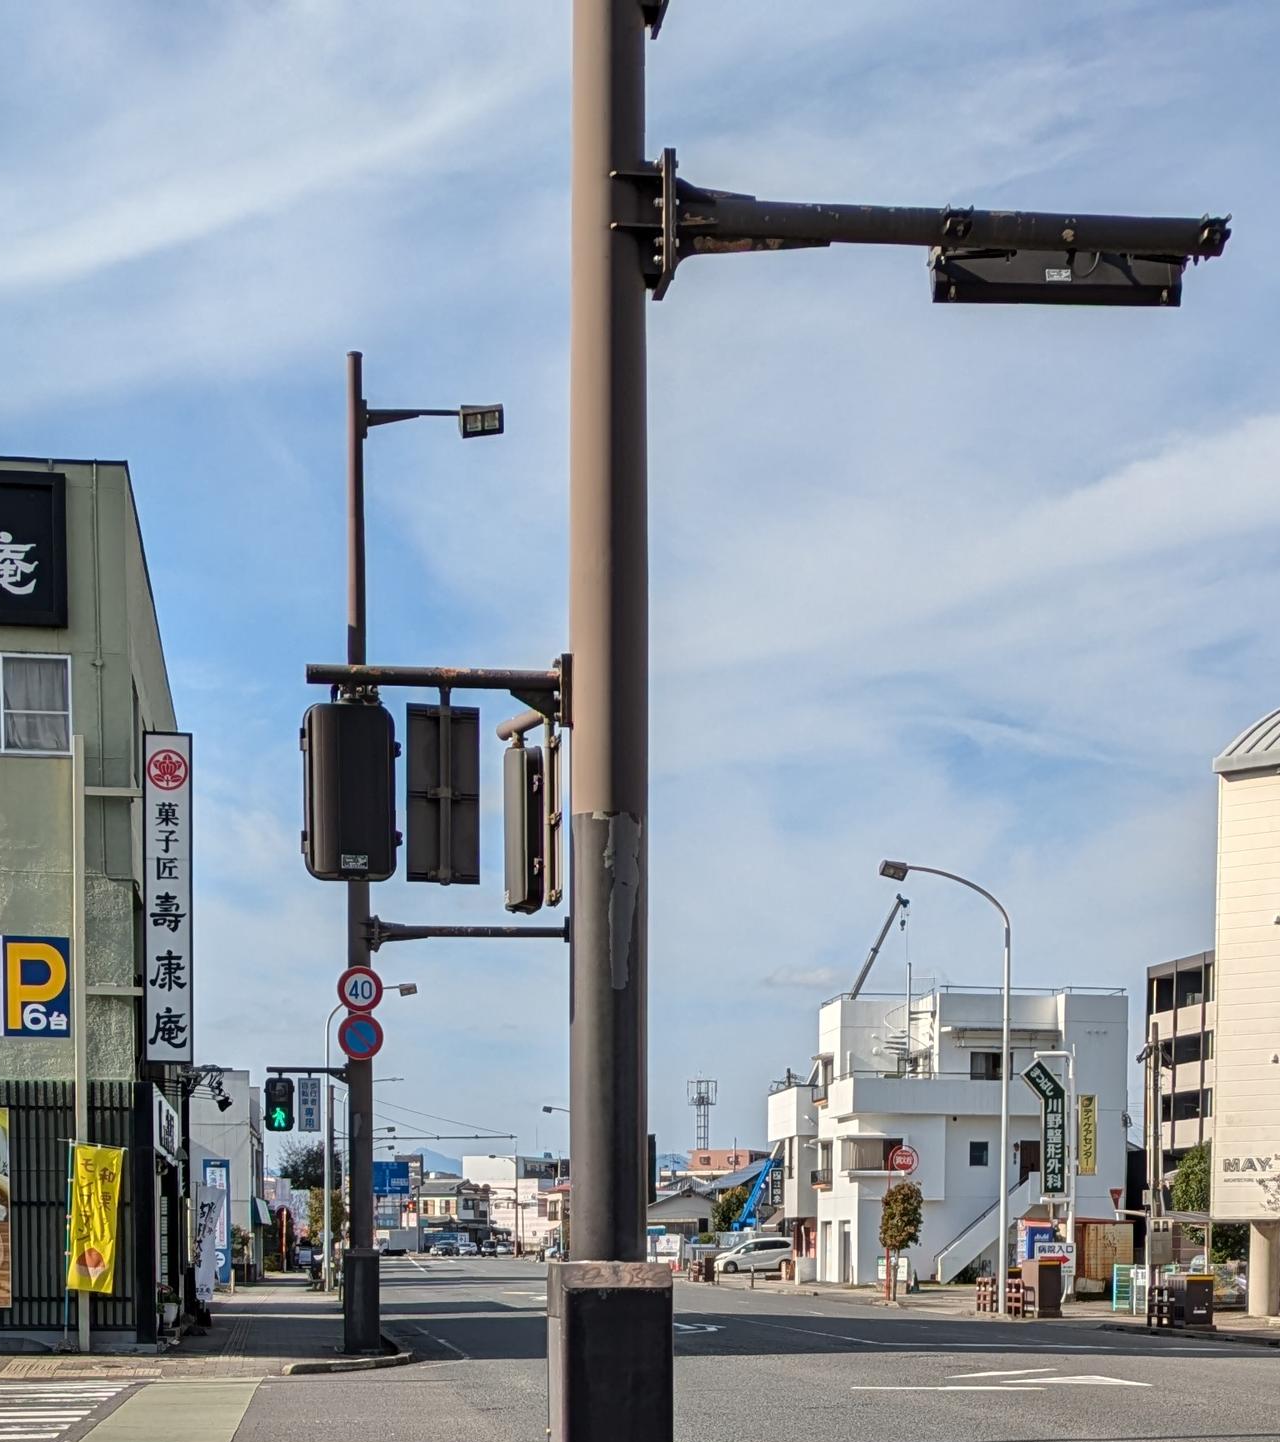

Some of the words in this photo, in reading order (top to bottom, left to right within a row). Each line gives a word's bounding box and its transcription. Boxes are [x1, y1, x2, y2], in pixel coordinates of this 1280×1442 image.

[155, 802, 179, 881] 菓子匠
[6, 942, 67, 1030] P
[149, 892, 187, 1049] 壽康庵
[349, 980, 373, 1000] 40
[23, 1003, 68, 1030] 6台
[1046, 1098, 1062, 1189] 川野整形外科
[1038, 1245, 1073, 1254] 病院入口
